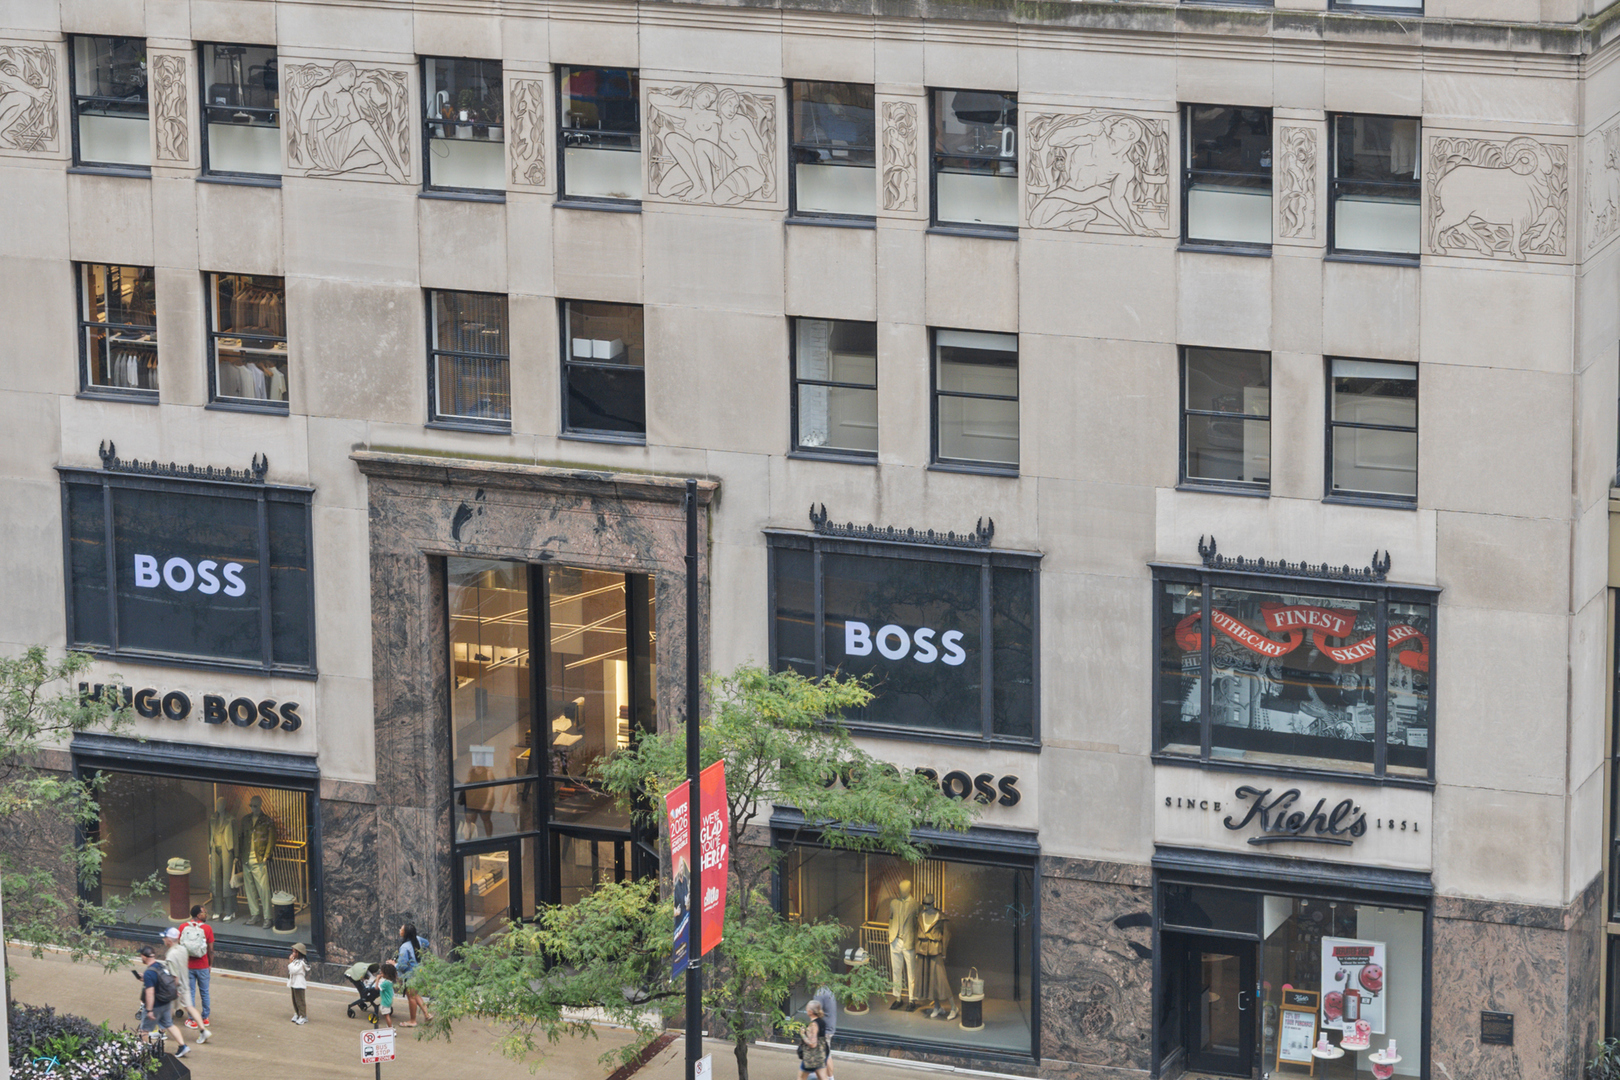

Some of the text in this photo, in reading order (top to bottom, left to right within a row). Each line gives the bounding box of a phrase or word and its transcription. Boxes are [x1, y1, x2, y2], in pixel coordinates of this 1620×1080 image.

[134, 553, 247, 597] BOSS
[1197, 609, 1287, 656] POTHECARY
[1274, 609, 1346, 633] FINEST
[845, 621, 967, 666] BOSS
[1331, 625, 1419, 661] SKINARE
[78, 681, 303, 733] HUGO BOSS
[670, 813, 688, 838] 2026
[675, 801, 688, 819] IMTS
[1165, 785, 1419, 838] SINCE Kiehl's 1851
[700, 819, 723, 844] GLAD
[700, 843, 727, 872] HERE!
